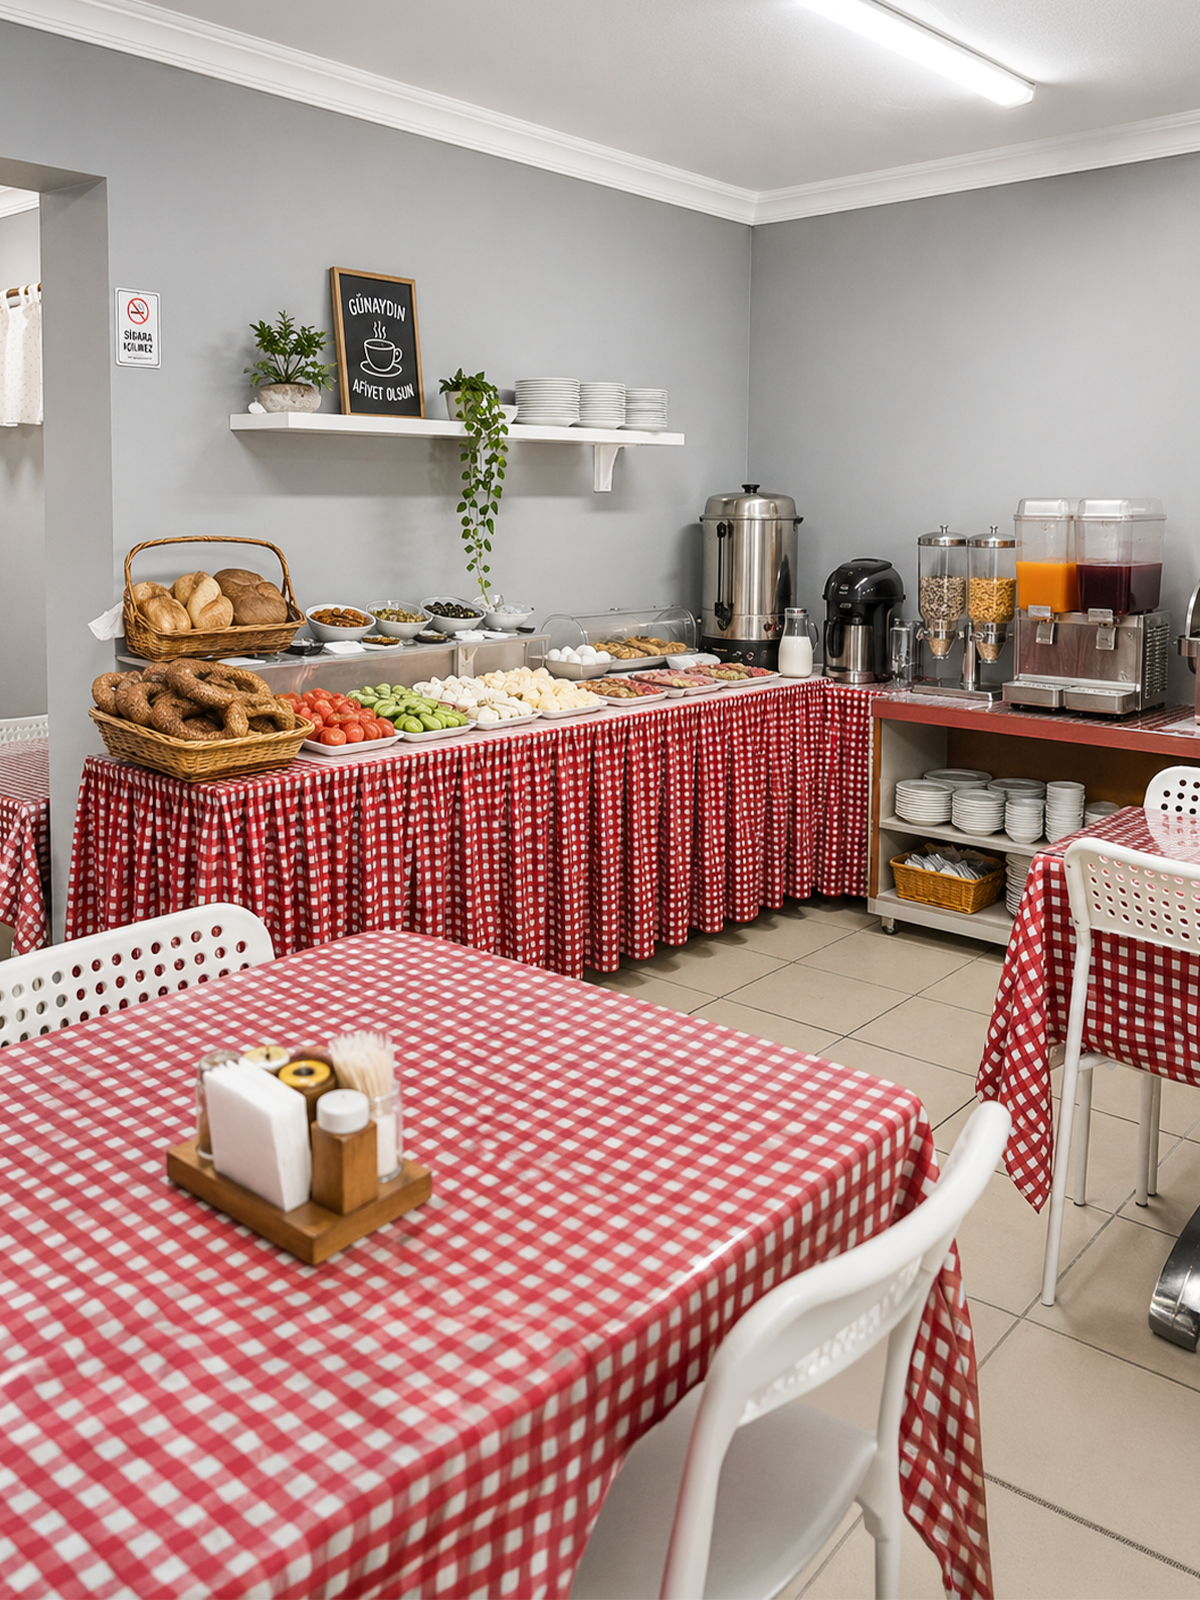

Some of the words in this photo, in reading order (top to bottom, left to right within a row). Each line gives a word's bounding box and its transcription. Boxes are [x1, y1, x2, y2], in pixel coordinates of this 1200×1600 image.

[348, 292, 406, 322] GÜNAYDIN
[352, 378, 384, 401] AFİYET
[386, 383, 415, 402] OLSUN
